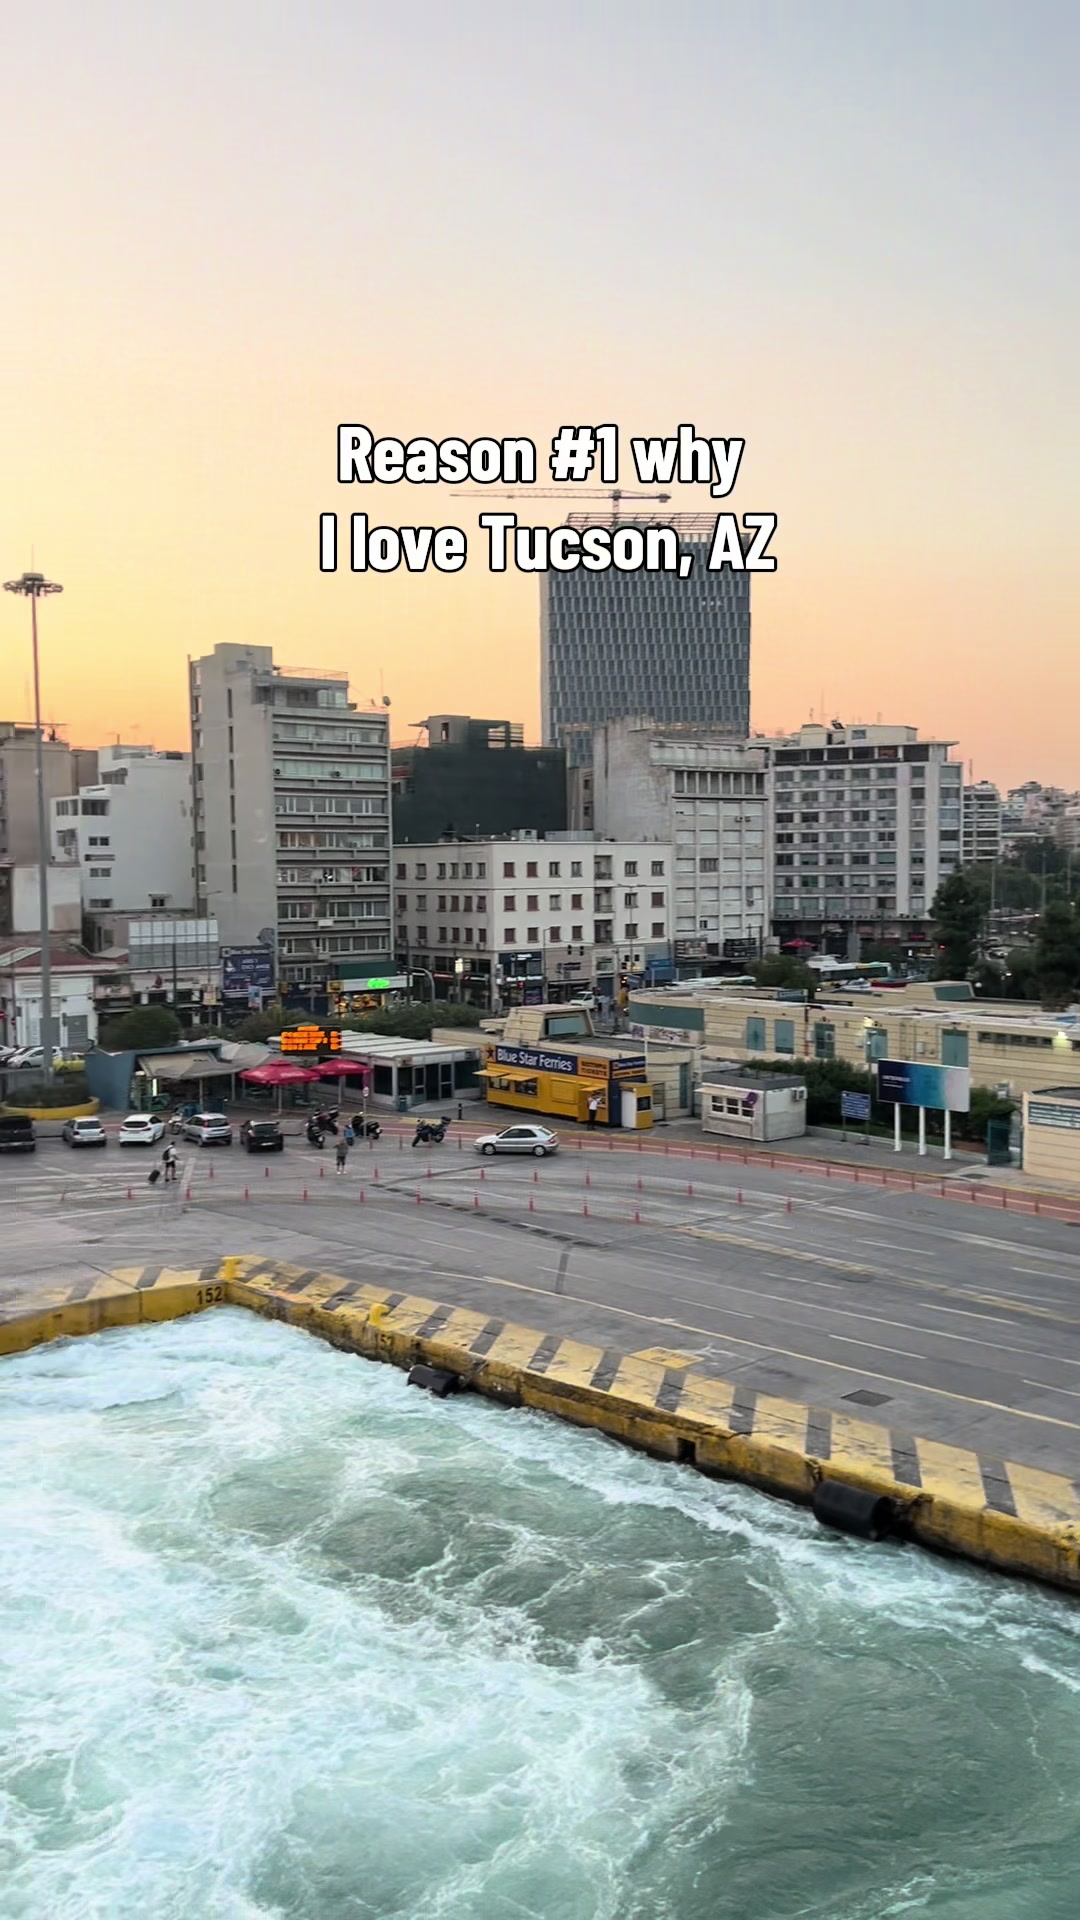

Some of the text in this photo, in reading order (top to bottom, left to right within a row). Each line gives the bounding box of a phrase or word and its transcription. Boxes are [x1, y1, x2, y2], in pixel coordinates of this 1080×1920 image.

[497, 1048, 518, 1063] Blue
[519, 1051, 538, 1066] Star
[539, 1054, 573, 1071] Ferries
[196, 1286, 223, 1305] 152
